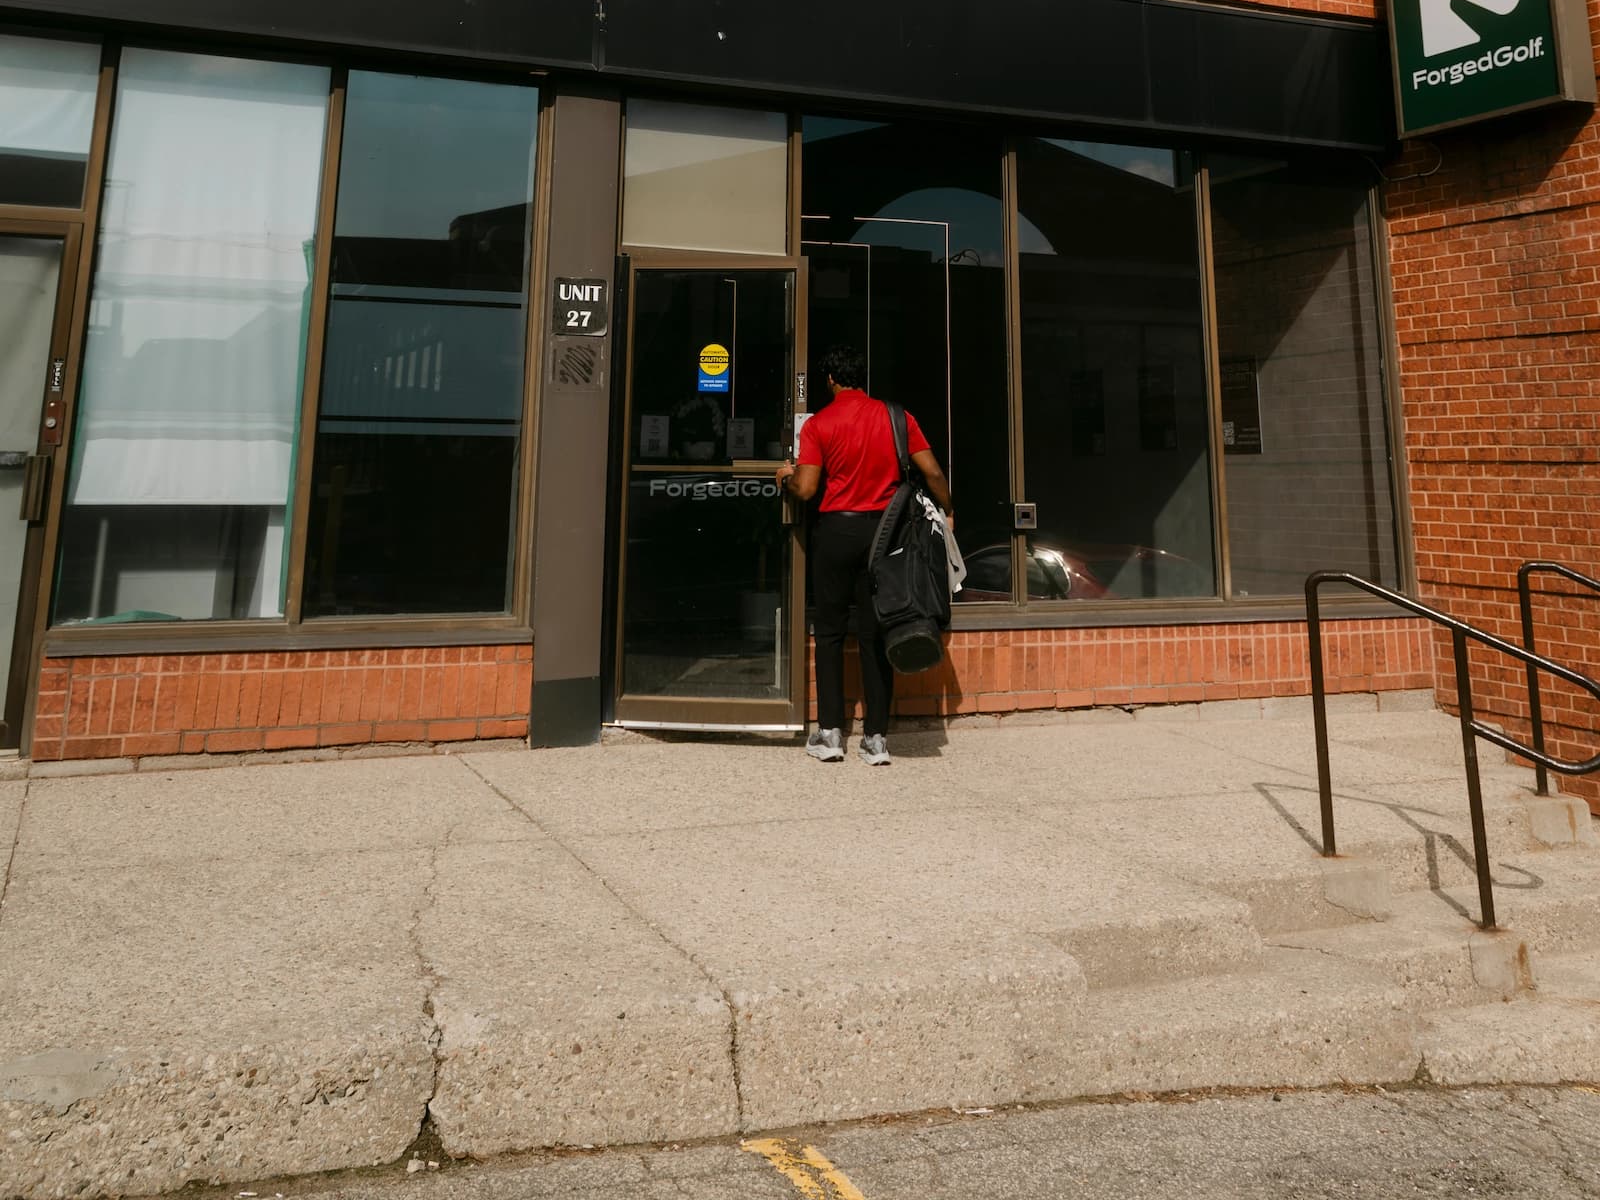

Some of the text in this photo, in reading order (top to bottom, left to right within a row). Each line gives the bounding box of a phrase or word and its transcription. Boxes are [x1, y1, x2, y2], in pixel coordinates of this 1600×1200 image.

[1412, 36, 1545, 91] ForgedGolf.
[559, 283, 603, 302] UNIT
[566, 310, 592, 327] 27
